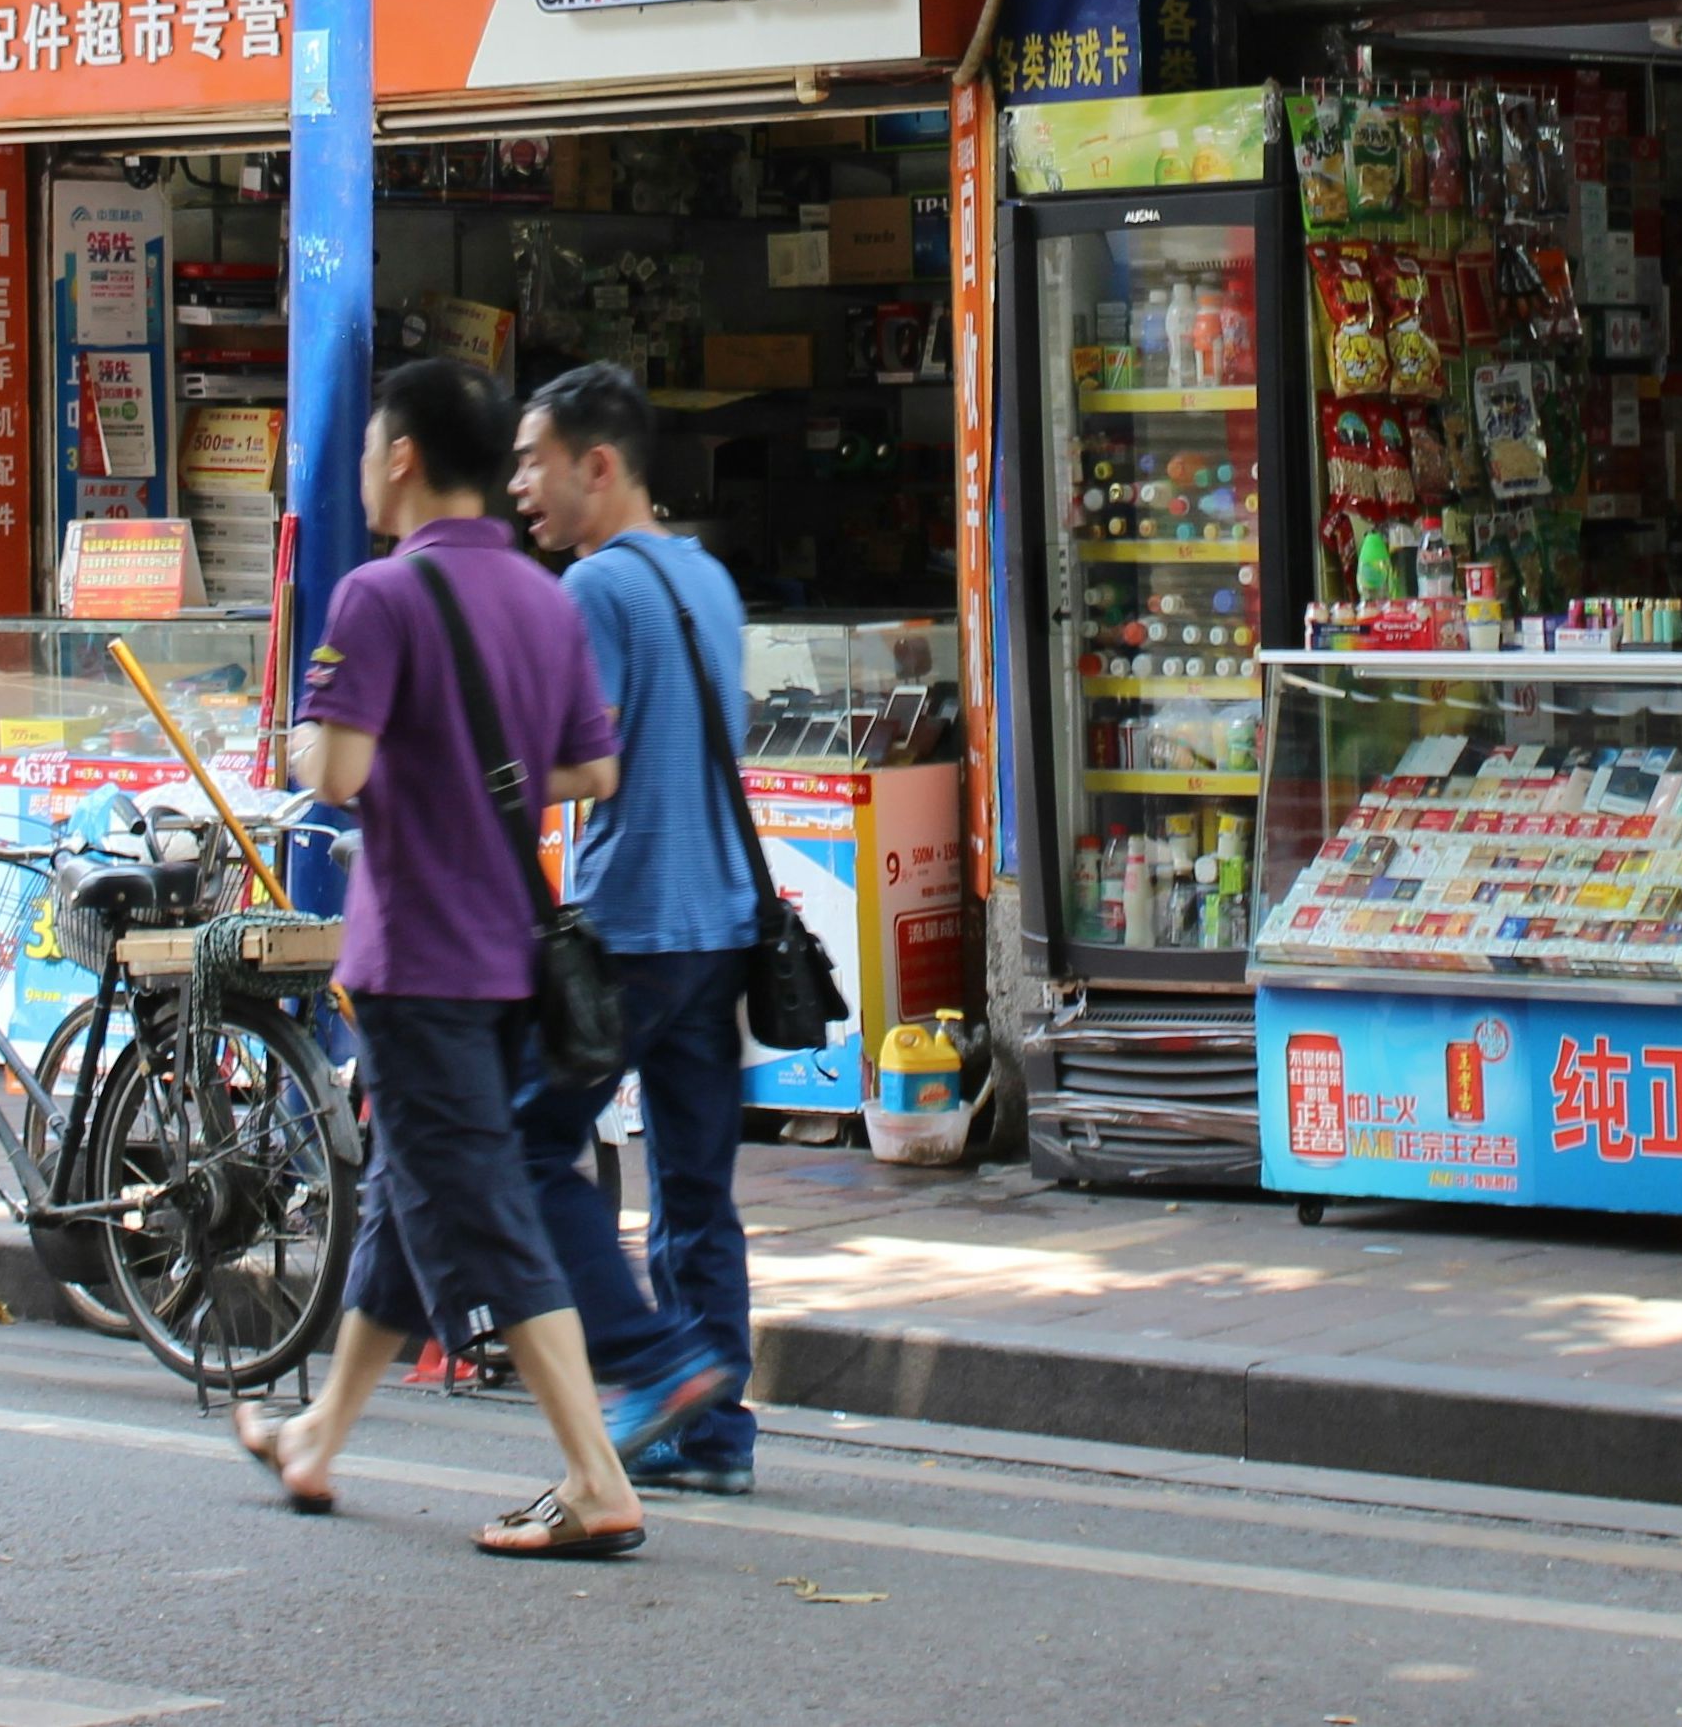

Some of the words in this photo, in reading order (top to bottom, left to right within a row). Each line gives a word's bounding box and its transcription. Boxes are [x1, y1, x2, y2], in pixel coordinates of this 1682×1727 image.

[996, 25, 1129, 96] 各类游戏卡
[86, 230, 137, 263] 领先
[12, 755, 71, 786] 4G来了
[1295, 1102, 1339, 1129] 正宗
[1346, 1091, 1418, 1126] 怕上火
[1291, 1127, 1345, 1153] 王老吉
[1348, 1126, 1517, 1168] 认准正宗王老吉
